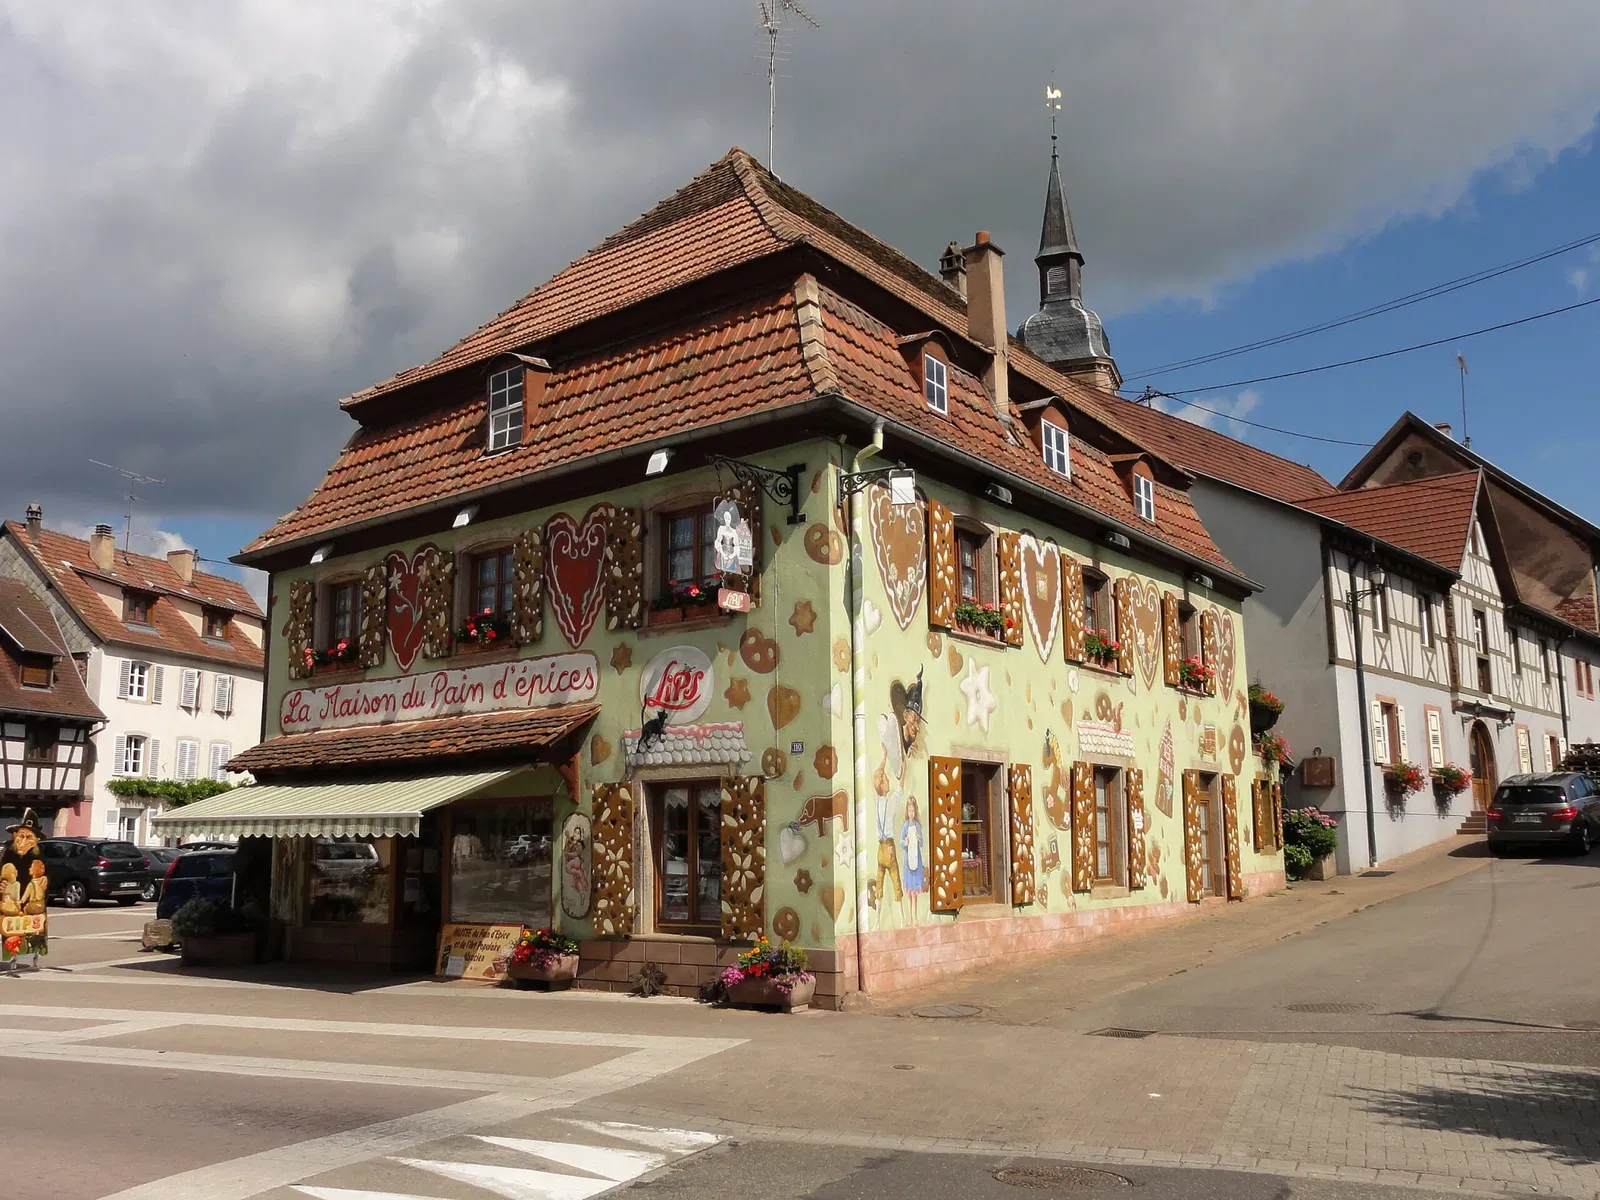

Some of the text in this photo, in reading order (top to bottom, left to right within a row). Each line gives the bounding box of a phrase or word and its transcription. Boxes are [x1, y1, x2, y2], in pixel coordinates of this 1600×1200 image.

[283, 662, 595, 724] La Maison du Pain d'épices
[6, 916, 41, 932] LIPS
[472, 929, 479, 938] du
[453, 941, 459, 949] et
